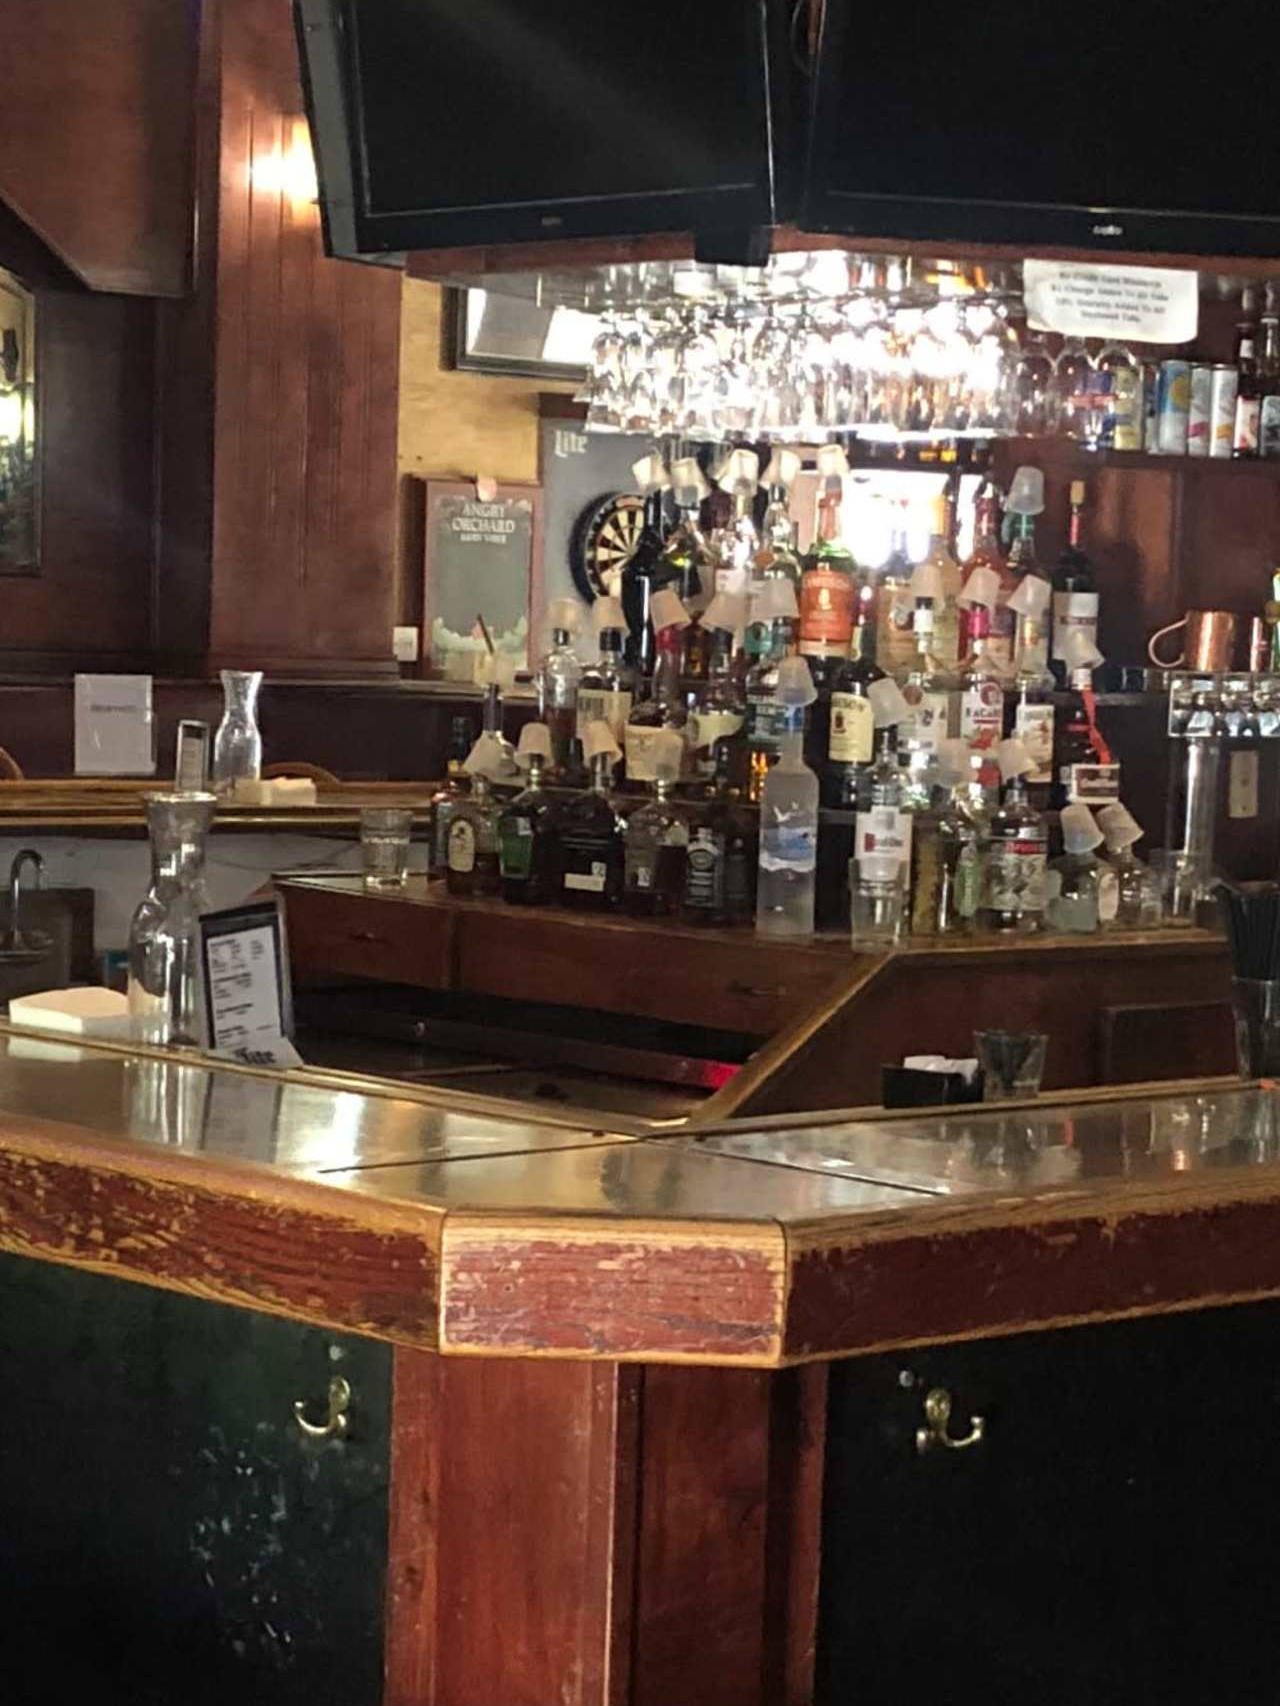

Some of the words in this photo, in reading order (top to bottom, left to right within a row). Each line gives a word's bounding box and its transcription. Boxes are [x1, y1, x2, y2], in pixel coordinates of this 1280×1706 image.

[554, 429, 589, 458] Lite
[462, 502, 506, 518] ANGRY
[451, 517, 517, 534] ORCHARD
